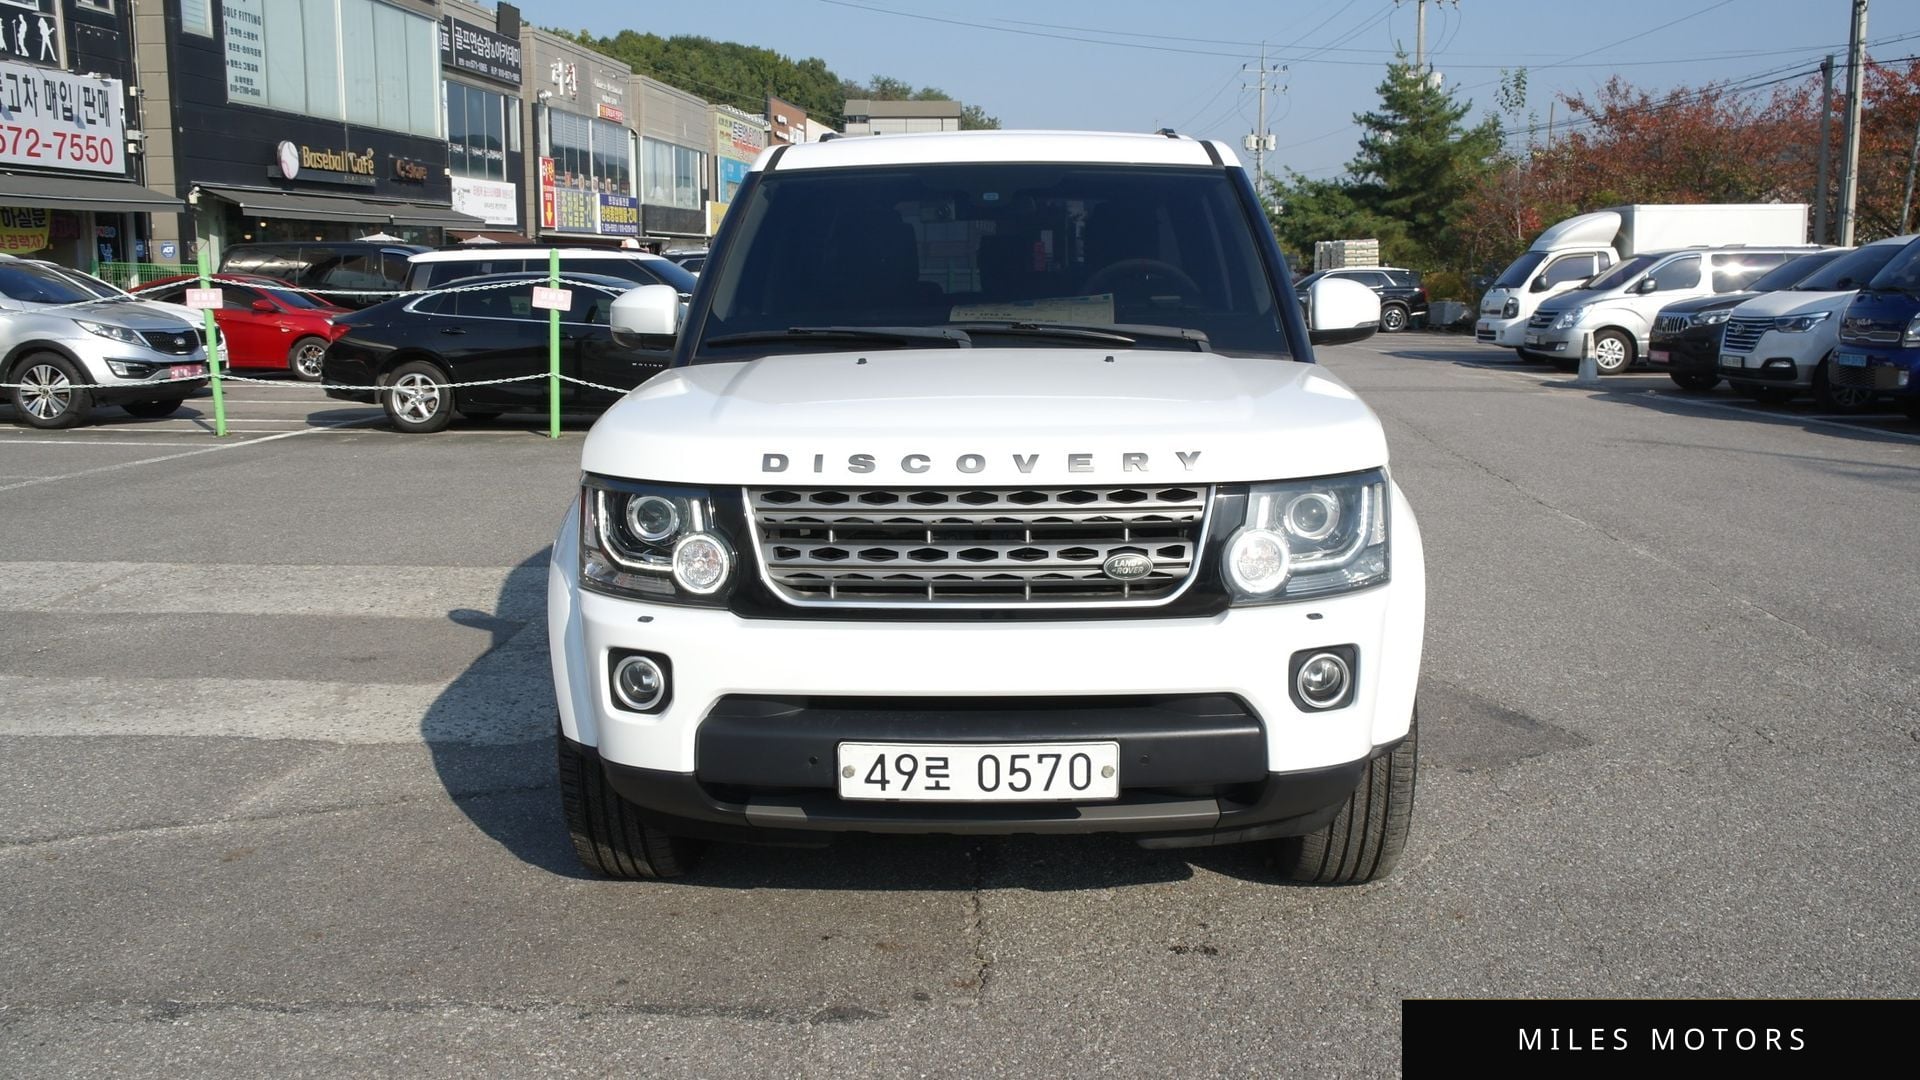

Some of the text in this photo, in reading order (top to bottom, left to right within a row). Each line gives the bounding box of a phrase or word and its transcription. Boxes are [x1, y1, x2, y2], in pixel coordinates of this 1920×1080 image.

[455, 26, 520, 69] 골프연습장&아카데미
[0, 72, 111, 127] 고차 매입/판매
[302, 146, 348, 172] Baseball
[761, 452, 1202, 474] DISCOVERY
[1114, 559, 1137, 567] LAND
[1116, 566, 1145, 575] ROVER
[864, 753, 1091, 792] 49로 0570
